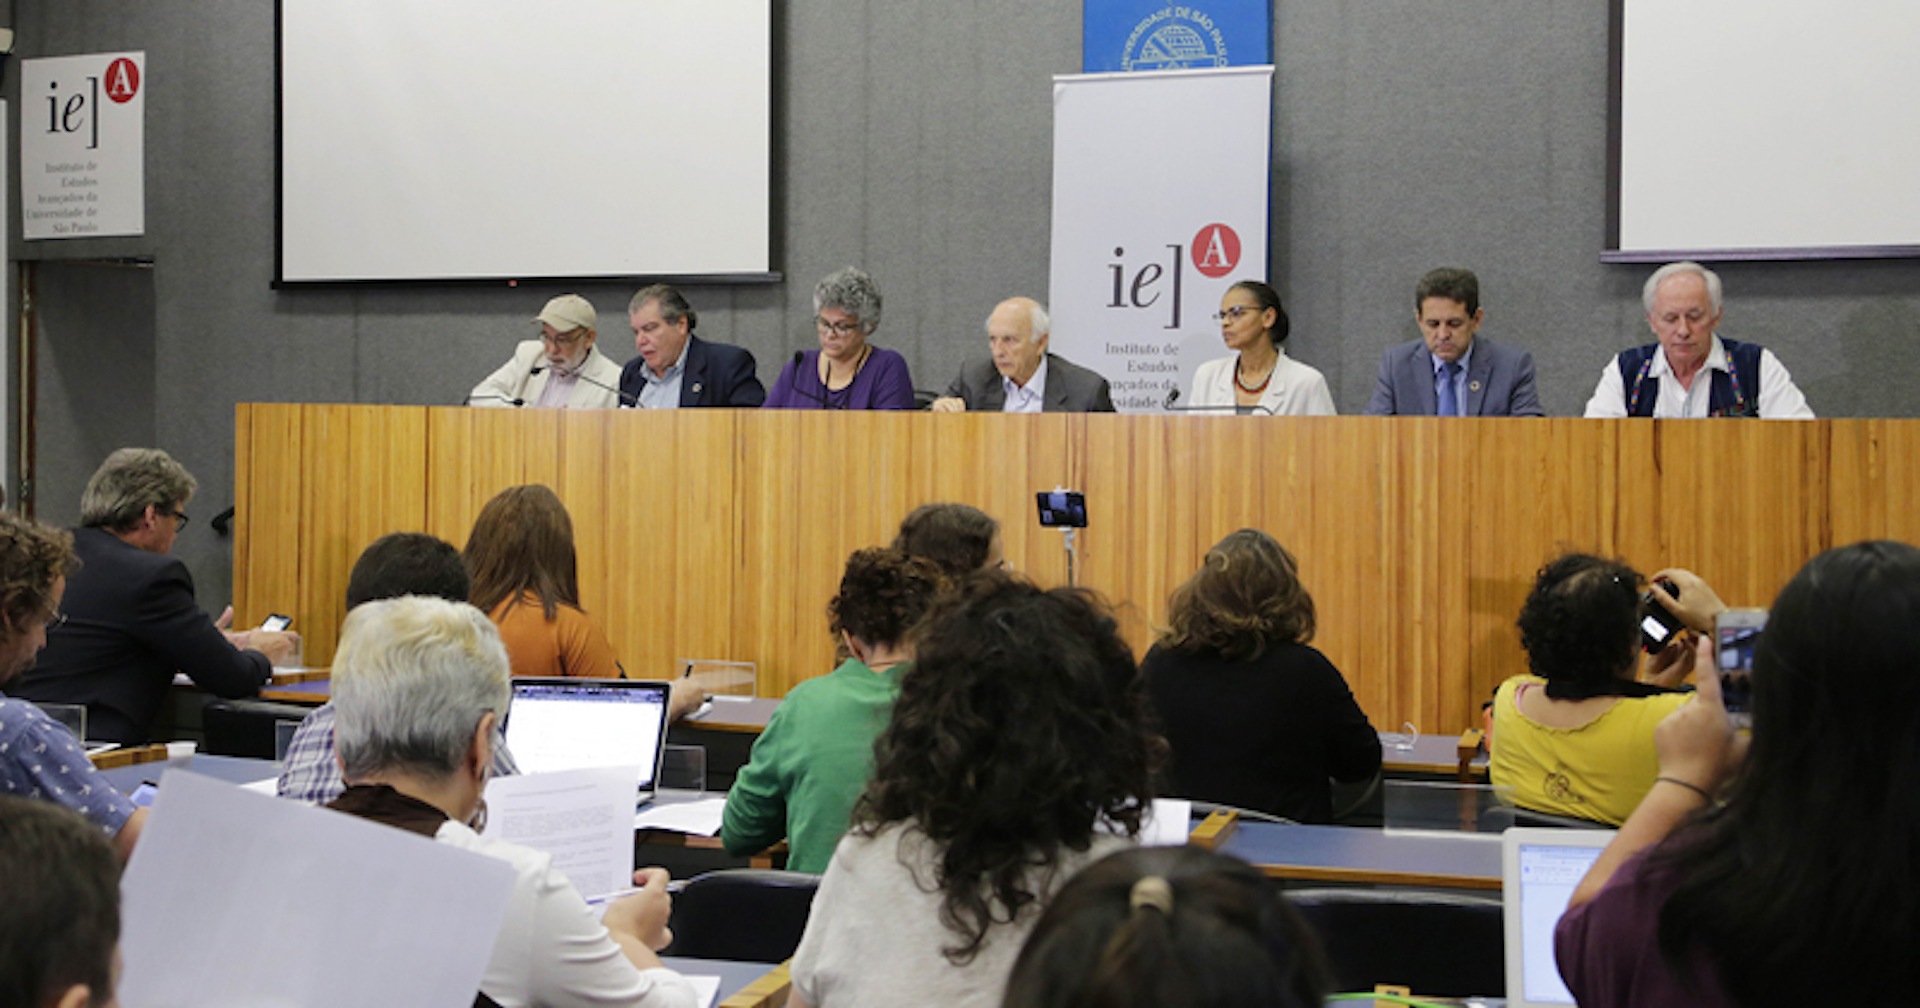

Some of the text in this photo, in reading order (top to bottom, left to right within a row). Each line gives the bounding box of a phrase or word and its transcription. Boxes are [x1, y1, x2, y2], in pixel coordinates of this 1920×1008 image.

[1121, 7, 1172, 70] NIVERSIDADE
[45, 160, 98, 173] Instituto de
[61, 176, 98, 188] Estudos
[26, 206, 98, 220] Universidade de
[71, 221, 99, 233] Paulo
[1105, 342, 1180, 355] Instituto de
[1127, 360, 1179, 373] Estudos
[1110, 378, 1159, 392] nçados
